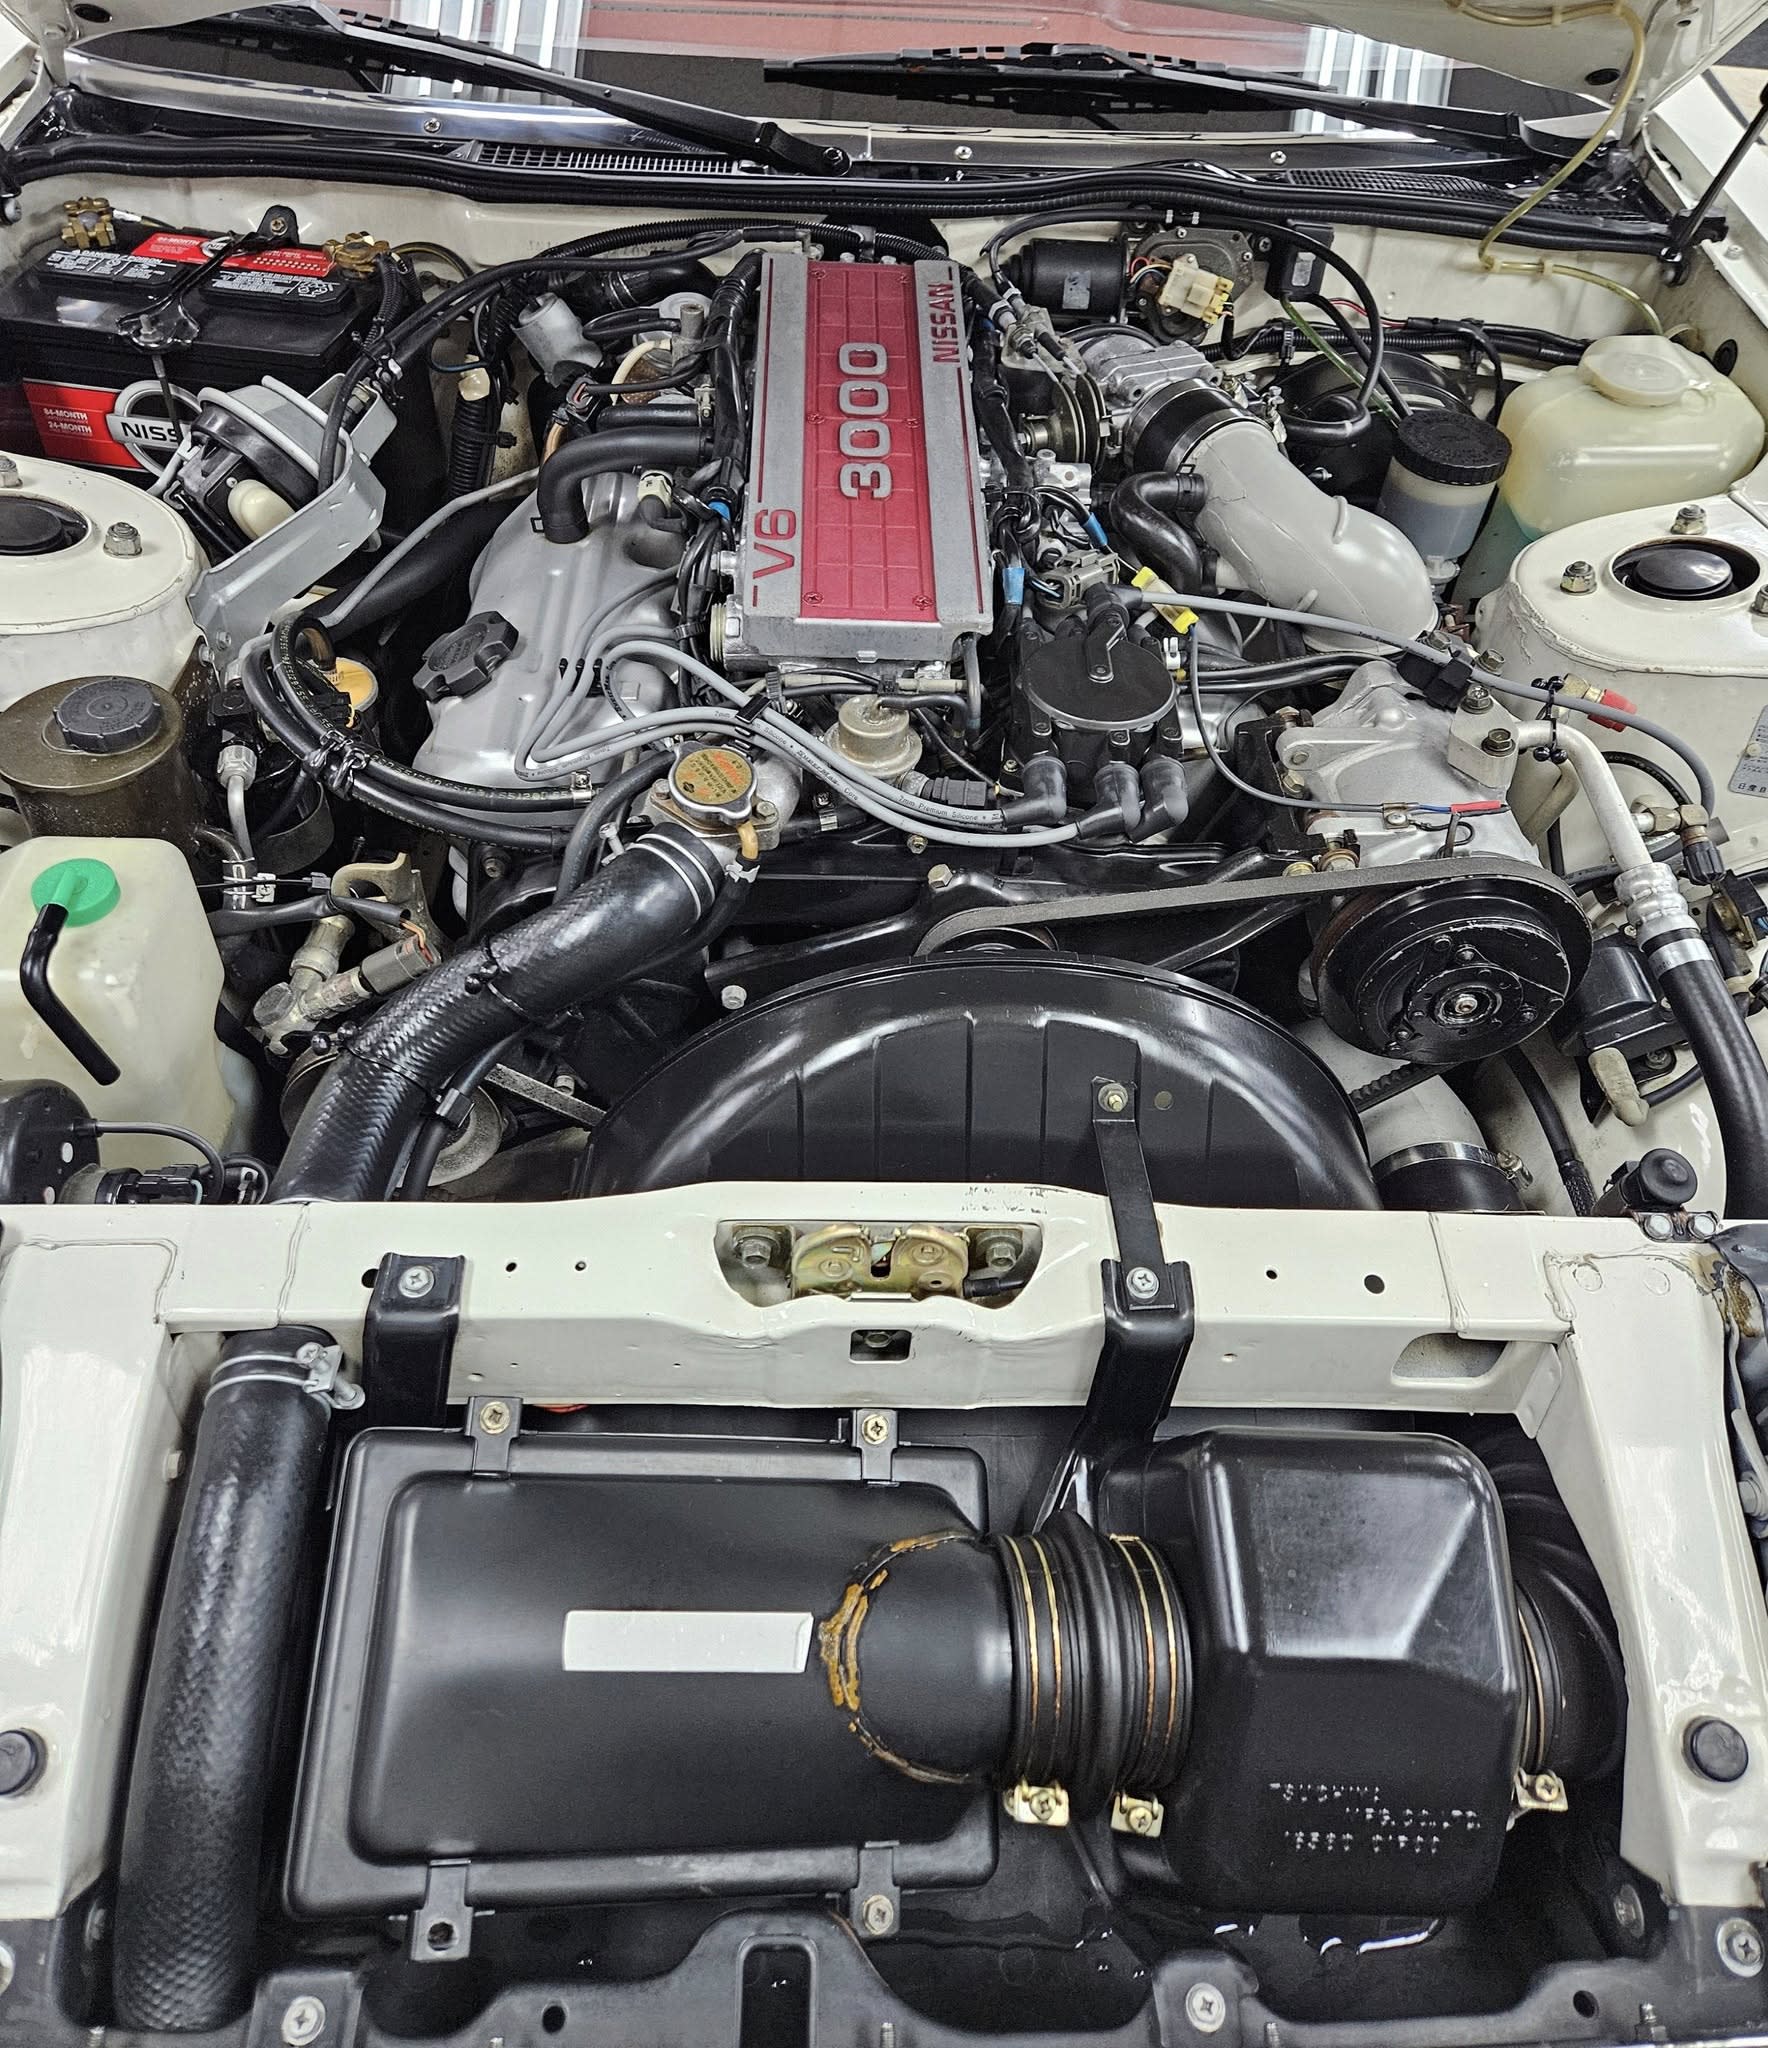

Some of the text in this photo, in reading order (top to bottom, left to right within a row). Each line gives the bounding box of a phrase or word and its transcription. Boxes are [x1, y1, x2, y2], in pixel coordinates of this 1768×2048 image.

[927, 282, 961, 364] NISSAN
[43, 407, 88, 420] 84-MONTH
[47, 420, 93, 433] 24-MONTH
[838, 341, 893, 499] 3000
[120, 421, 179, 442] NISS
[752, 508, 797, 579] V6
[898, 794, 916, 807] 7mm
[918, 802, 948, 817] Premium
[951, 811, 979, 822] Silicone
